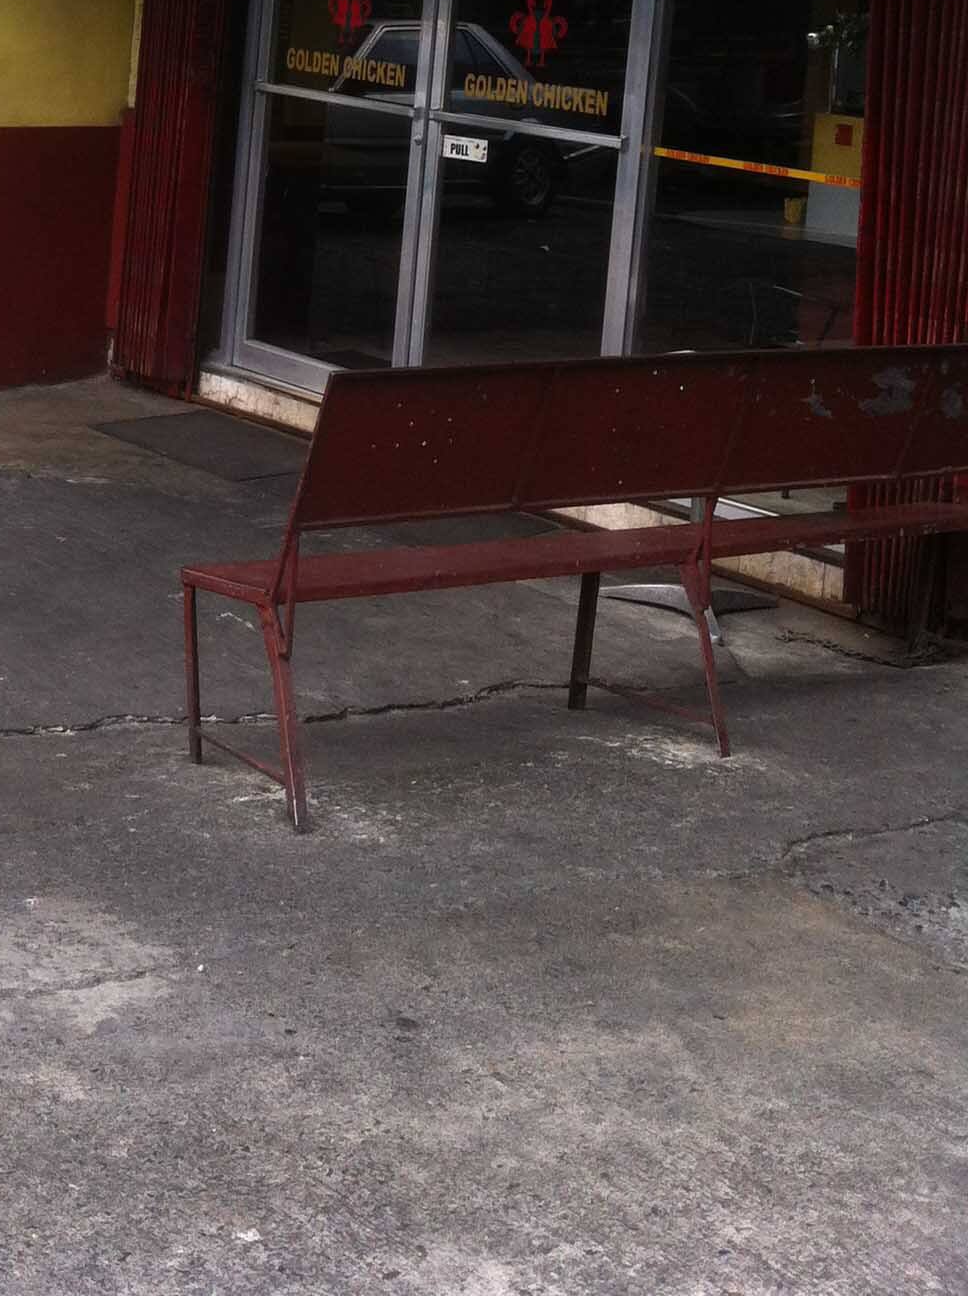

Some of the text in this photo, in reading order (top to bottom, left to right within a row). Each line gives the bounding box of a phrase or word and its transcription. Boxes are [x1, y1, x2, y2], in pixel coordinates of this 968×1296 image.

[286, 47, 407, 88] GOLDEN CHICKEN
[463, 72, 609, 117] GOLDEN CHICKEN
[450, 143, 470, 157] PULL
